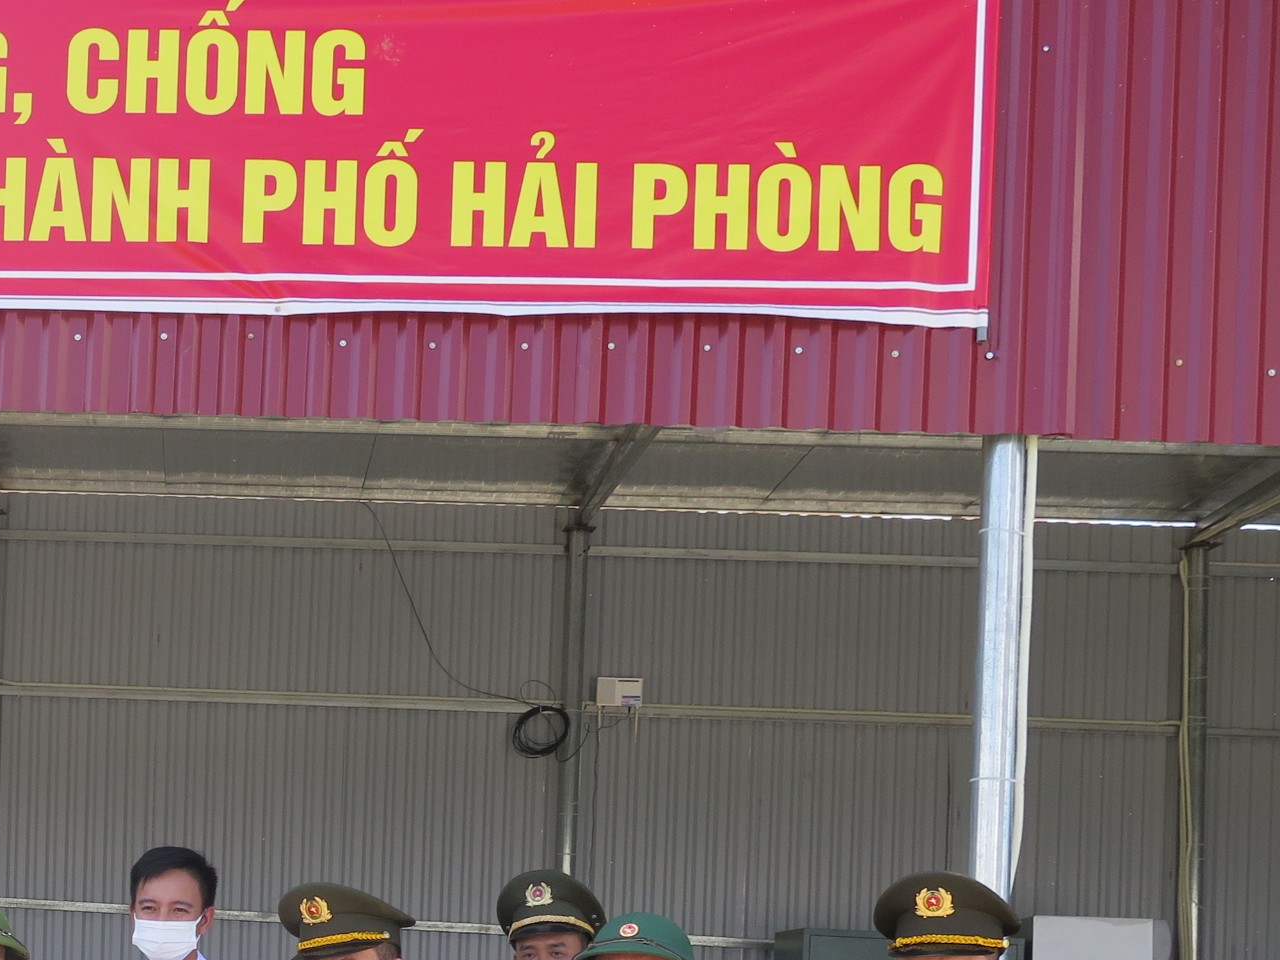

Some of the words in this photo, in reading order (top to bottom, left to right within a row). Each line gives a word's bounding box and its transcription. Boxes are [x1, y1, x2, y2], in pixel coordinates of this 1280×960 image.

[67, 0, 365, 117] CHỐNG
[242, 129, 424, 247] PHỐ
[451, 132, 597, 249] HẢI
[631, 142, 943, 254] PHÒNG
